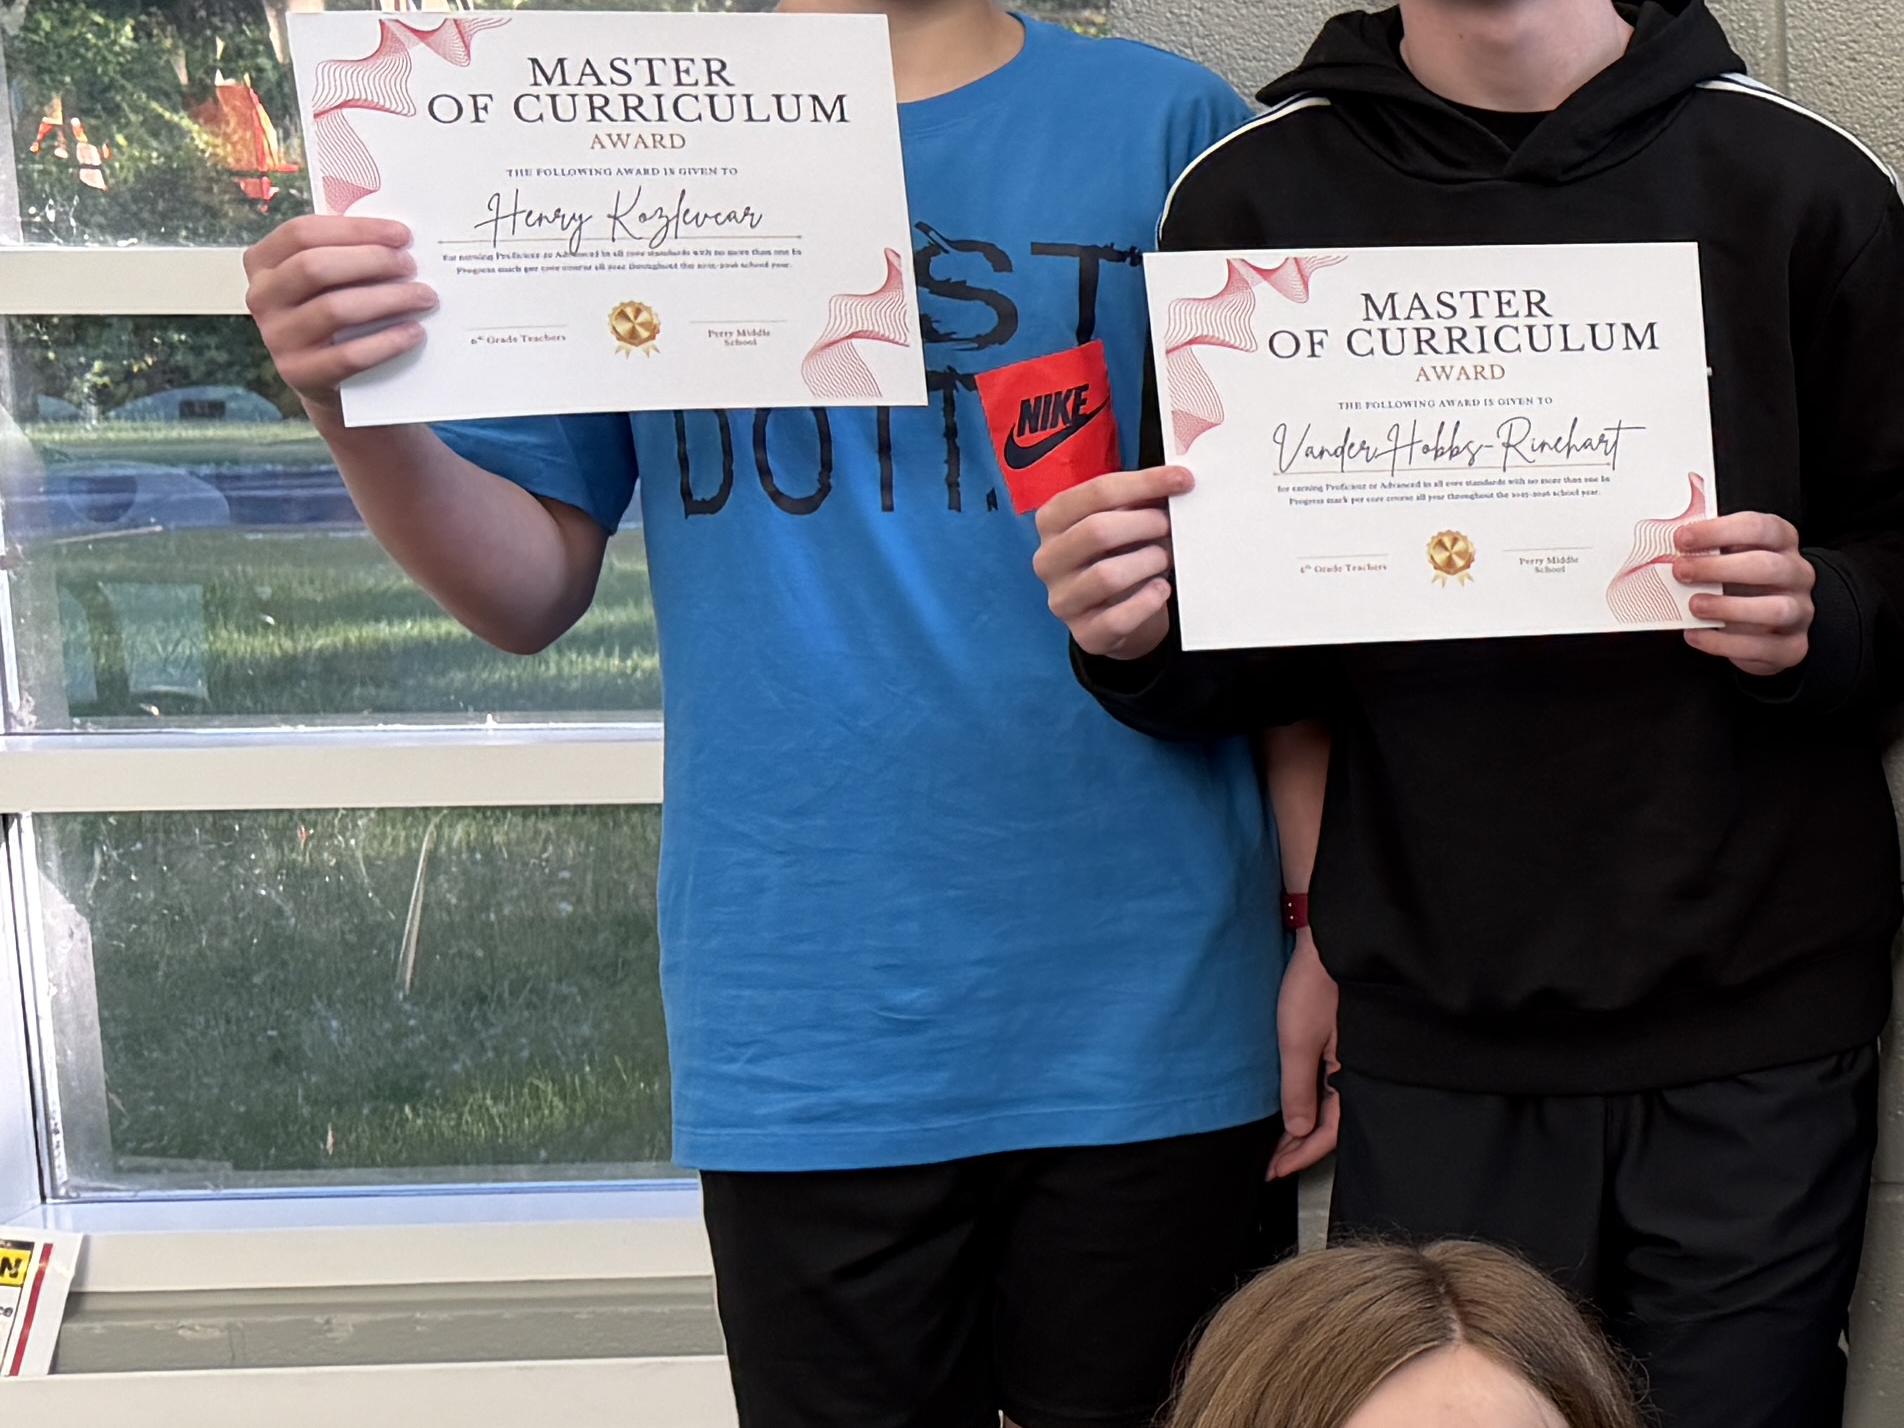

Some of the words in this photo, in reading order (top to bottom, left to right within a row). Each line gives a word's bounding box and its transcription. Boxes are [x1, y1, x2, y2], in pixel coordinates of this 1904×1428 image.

[528, 57, 734, 86] MASTER
[428, 94, 493, 123] OF
[513, 93, 849, 122] CURRICULUM
[590, 133, 685, 149] AWARD
[473, 188, 593, 255] Henry
[1360, 290, 1552, 321] MASTER
[1268, 329, 1328, 358] OF
[1347, 322, 1658, 356] CURRICULUM
[1415, 364, 1505, 381] AWARD
[1016, 383, 1090, 439] NIKE
[1337, 401, 1362, 410] THE
[1438, 398, 1481, 408] AWARD
[1483, 397, 1494, 407] IS
[1497, 396, 1534, 406] GIVEN
[1536, 396, 1553, 405] TO
[1272, 422, 1377, 473] Vander
